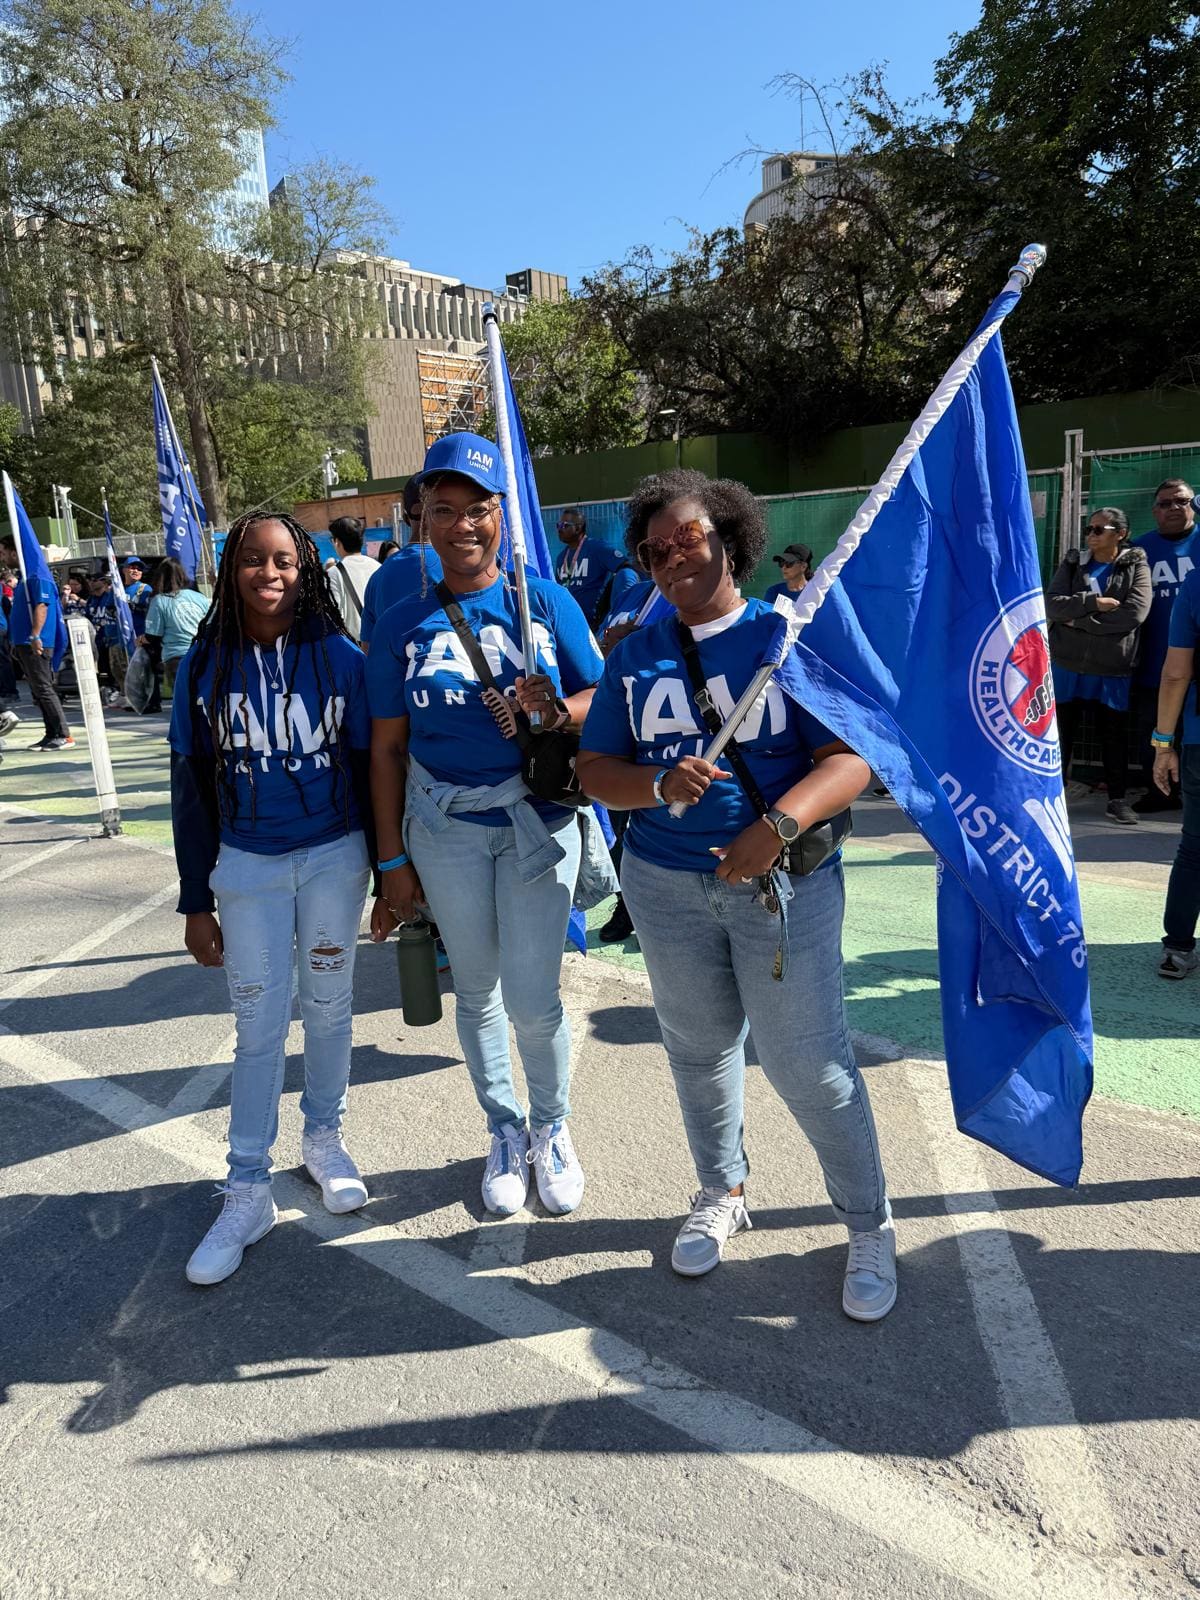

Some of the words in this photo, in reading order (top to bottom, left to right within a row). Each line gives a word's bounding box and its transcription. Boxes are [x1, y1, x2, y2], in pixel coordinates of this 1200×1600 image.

[467, 448, 493, 469] IAM
[469, 460, 490, 473] UNION
[937, 772, 1062, 922] DISTRICT
